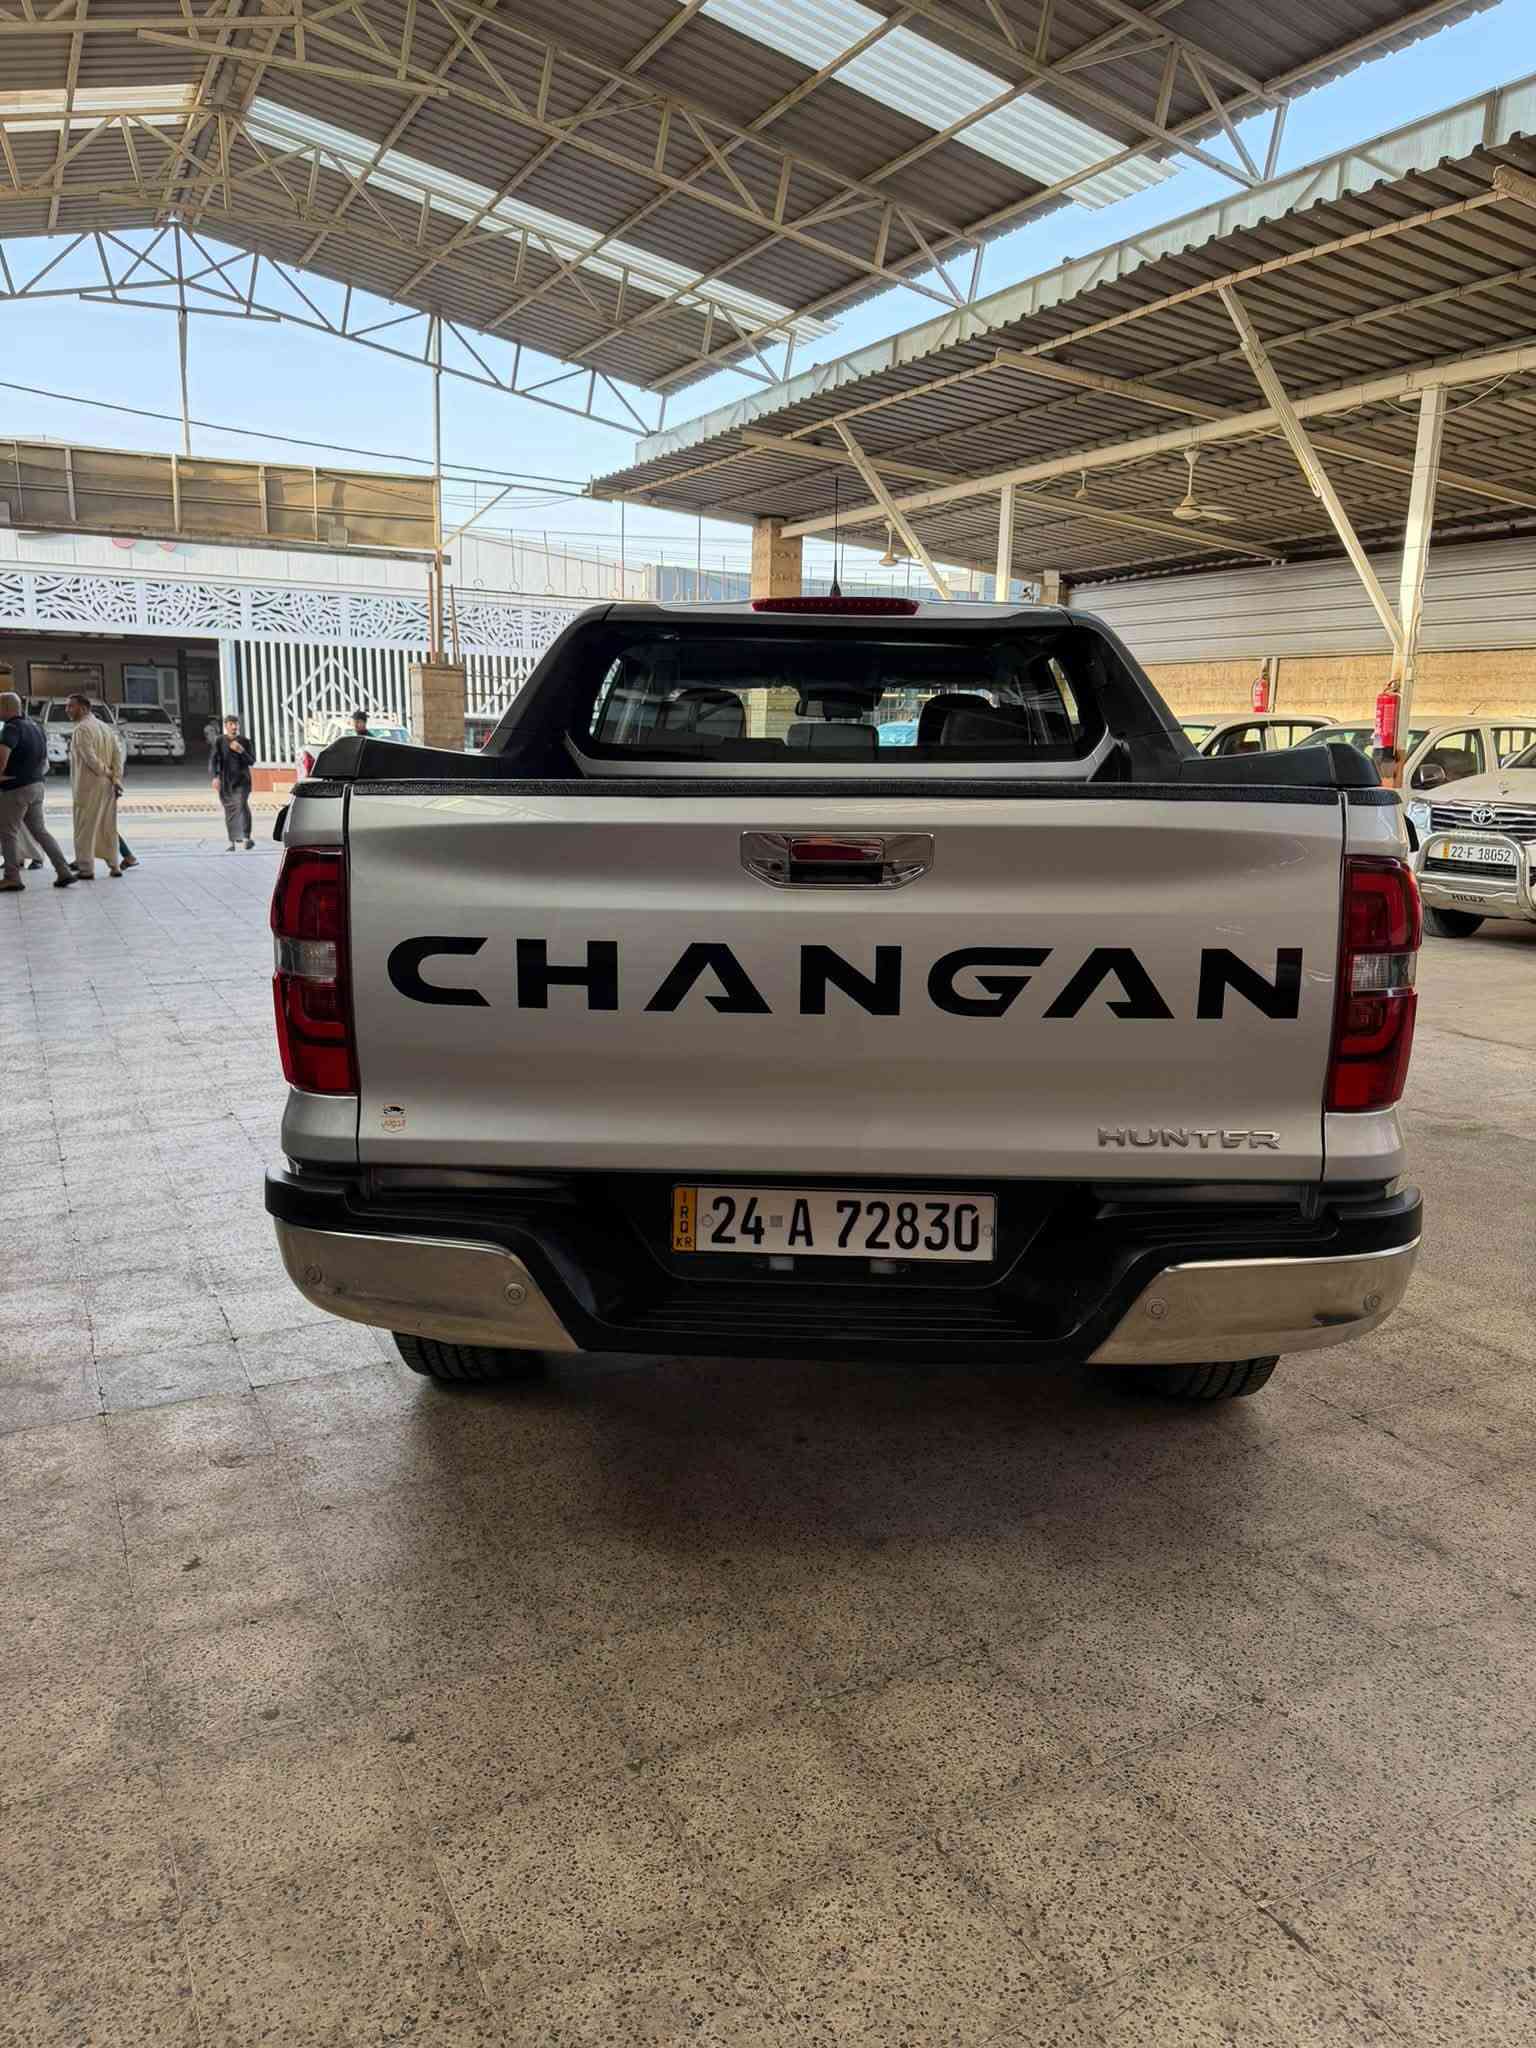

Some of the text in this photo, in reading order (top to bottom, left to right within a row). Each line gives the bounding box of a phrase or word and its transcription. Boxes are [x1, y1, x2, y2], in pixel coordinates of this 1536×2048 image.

[1451, 846, 1463, 858] 22
[1479, 848, 1511, 863] 18052
[387, 936, 1303, 1020] CHANGAN
[1098, 1127, 1280, 1150] HUNTER
[711, 1196, 980, 1252] 24 A 72830
[675, 1236, 693, 1248] KR
